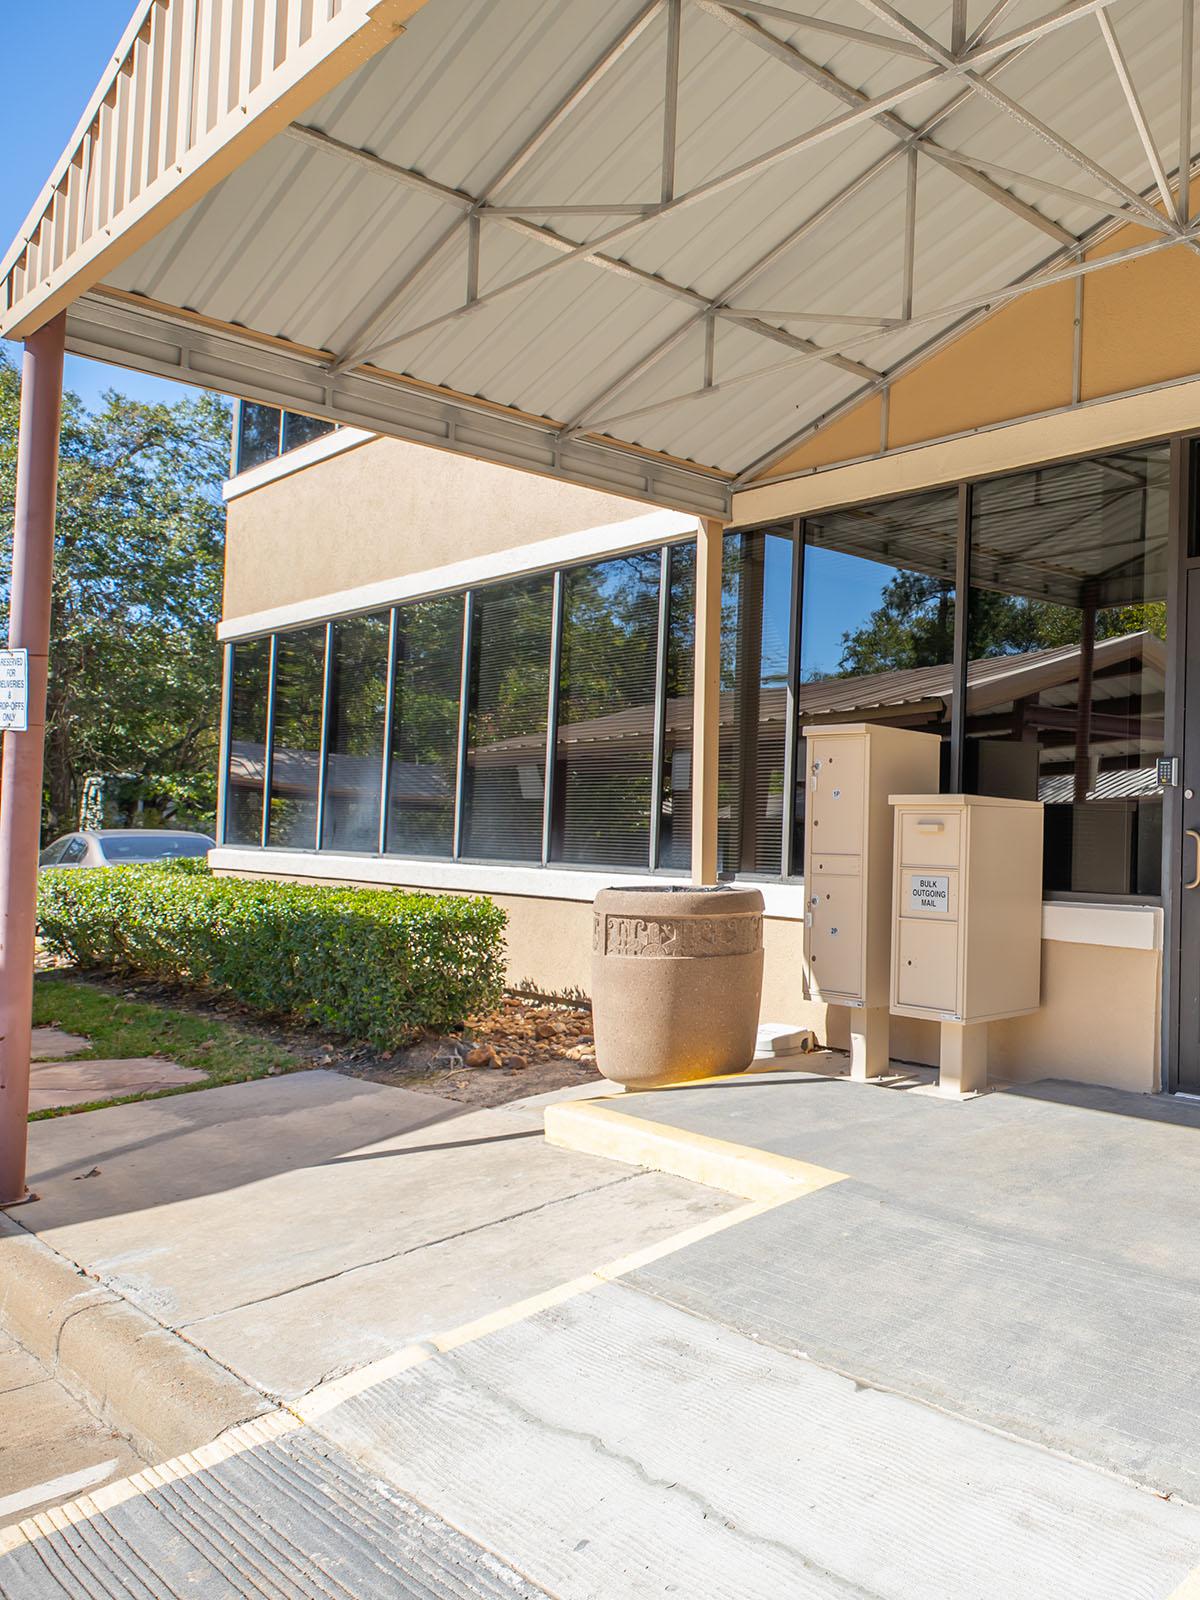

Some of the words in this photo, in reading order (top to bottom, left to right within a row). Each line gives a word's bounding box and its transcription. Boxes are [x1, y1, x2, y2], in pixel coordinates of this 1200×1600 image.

[7, 668, 16, 677] FOR
[0, 679, 25, 689] ELIVERIES
[0, 701, 25, 711] ROP-OFFS
[3, 712, 16, 722] ONLY
[919, 880, 938, 888] BULK
[912, 888, 946, 899] OUTGOING
[920, 899, 937, 907] MAIL
